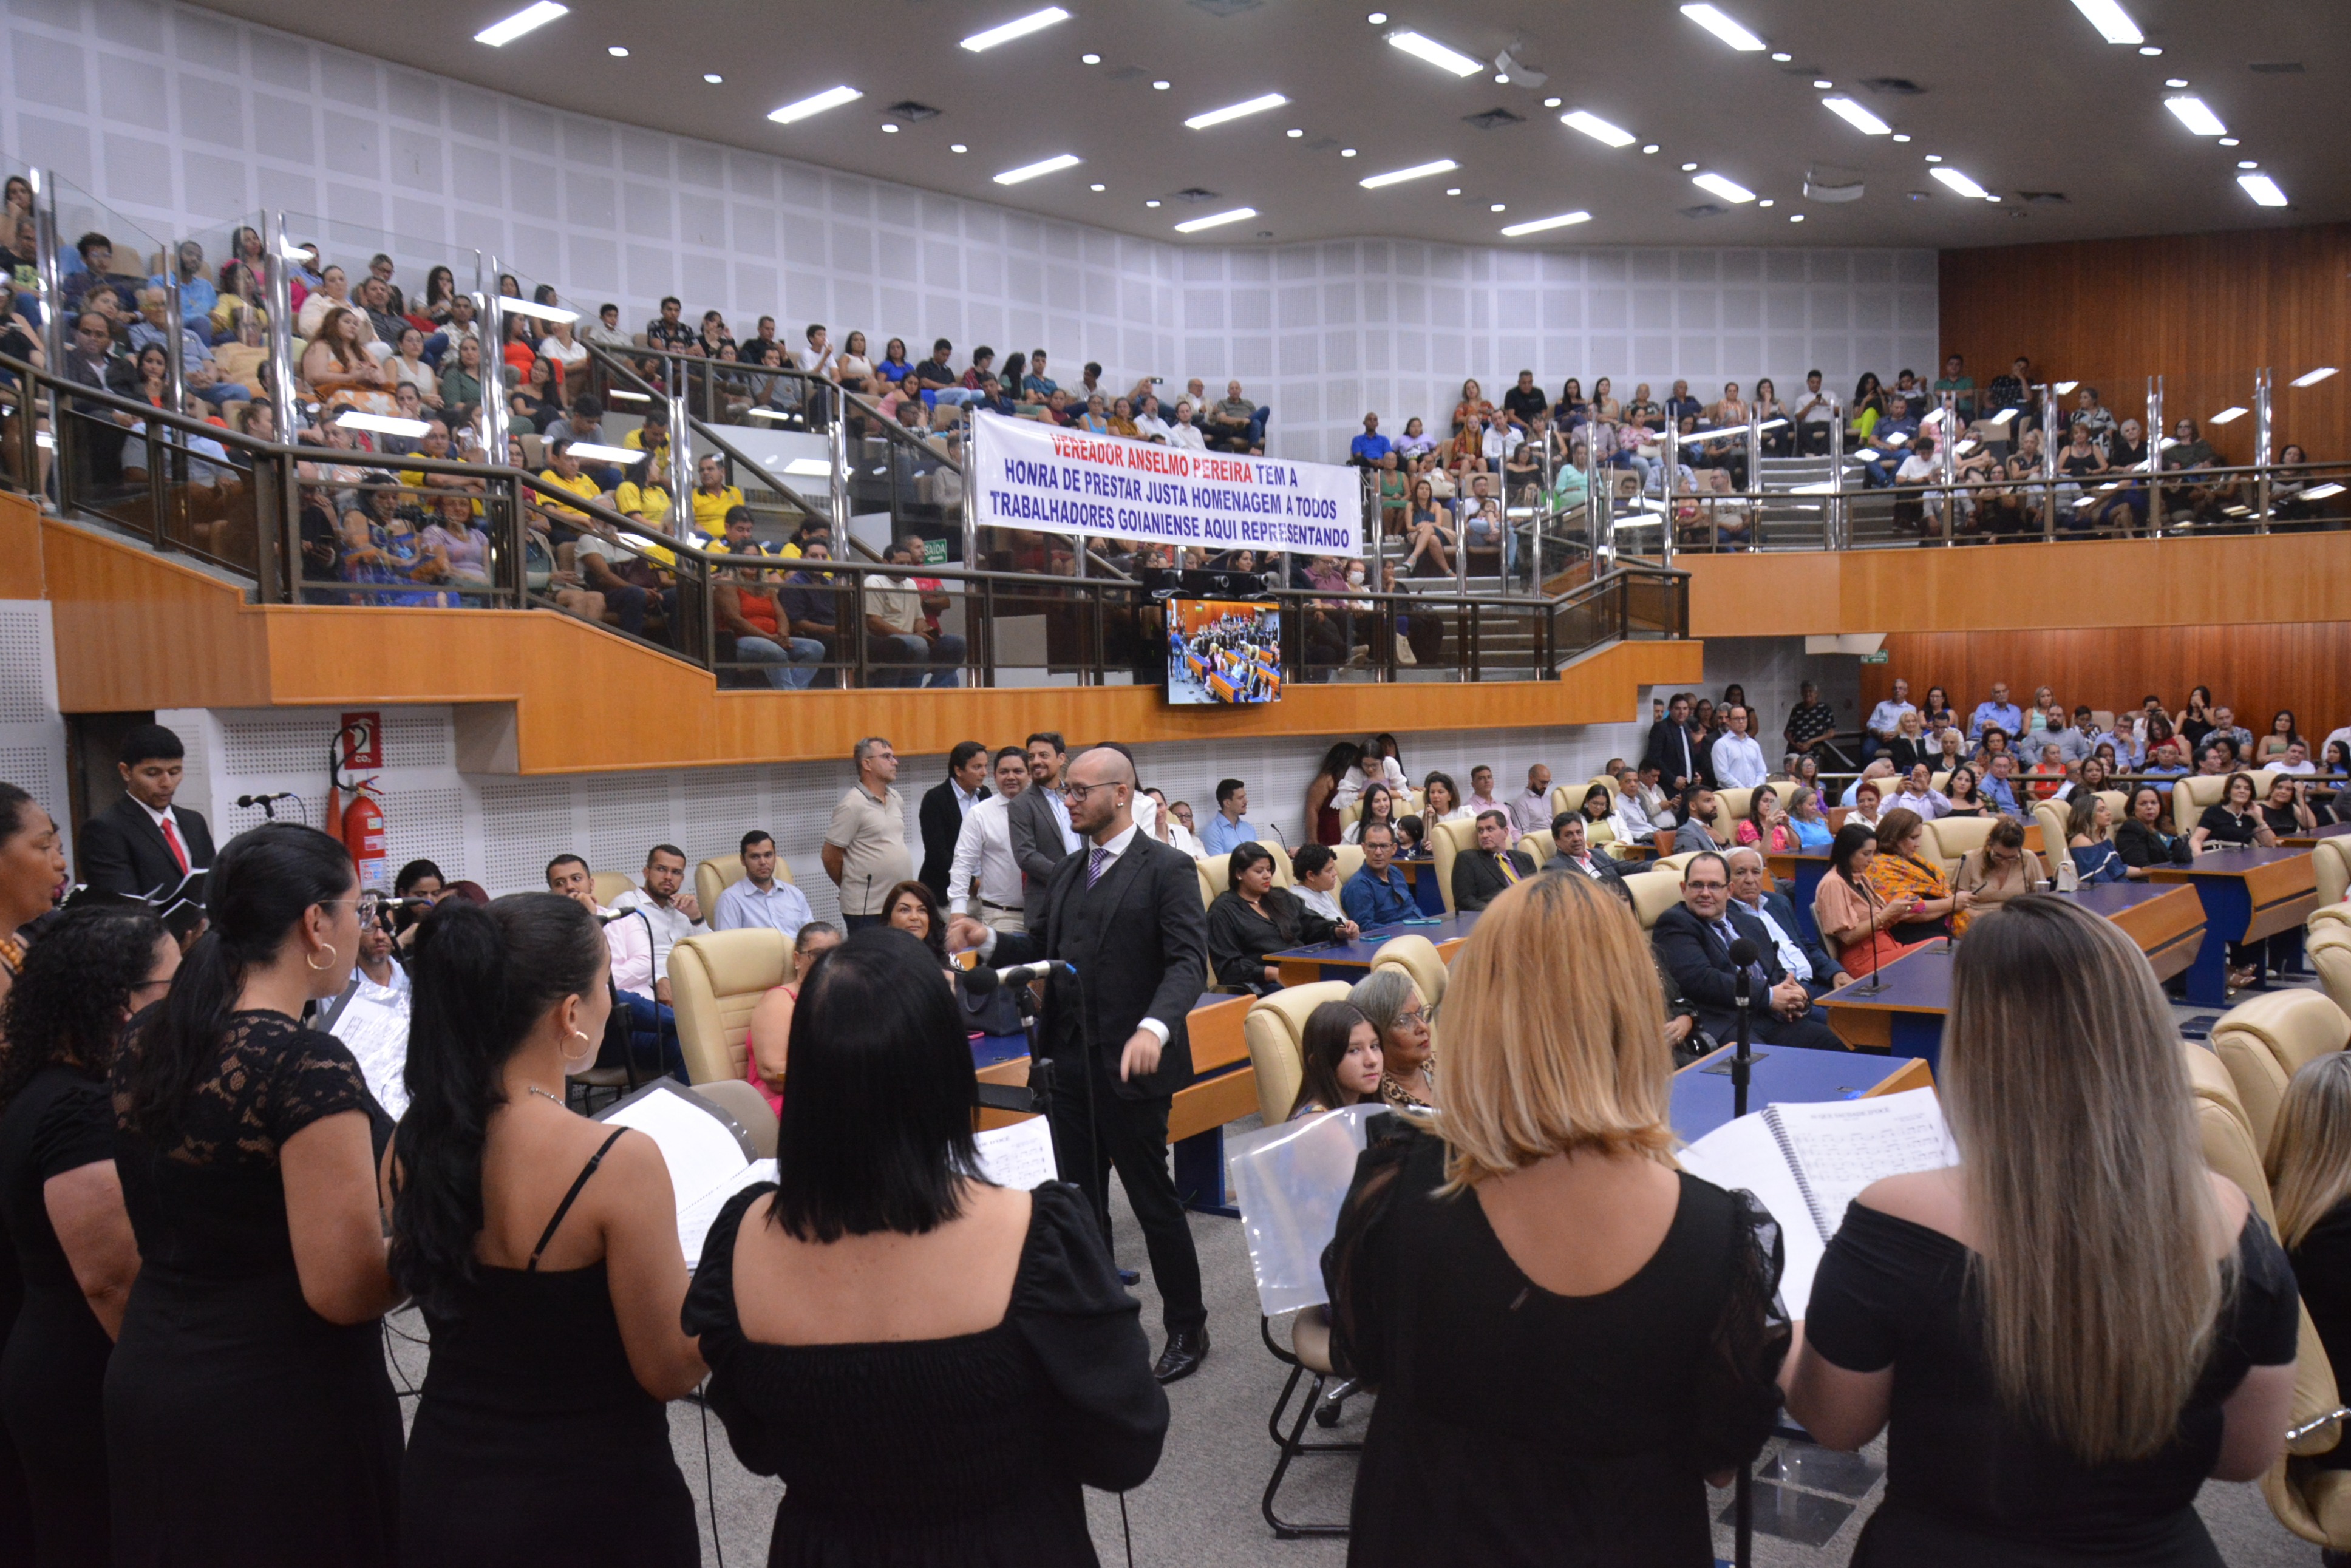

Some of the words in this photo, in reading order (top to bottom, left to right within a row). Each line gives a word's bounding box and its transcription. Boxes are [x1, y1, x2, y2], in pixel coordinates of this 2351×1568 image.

[1050, 433, 1124, 467] VEREADOR
[1128, 447, 1189, 477] ANSELMO
[1193, 456, 1253, 483] PEREIRA
[1256, 463, 1286, 486] TEM
[1290, 467, 1298, 487] A
[1004, 458, 1059, 489] HONRA
[1063, 467, 1081, 492] DE
[1084, 471, 1143, 501] PRESTAR
[1146, 481, 1188, 507] JUSTA
[1191, 486, 1282, 515] HOMENAGEM
[1286, 495, 1293, 515] A
[1295, 497, 1337, 520] TODOS
[990, 490, 1115, 529] TRABALHADORES
[1118, 508, 1200, 537] GOIANIENSE
[1204, 517, 1237, 540] AQUI
[1240, 520, 1349, 548] REPRESENTANDO
[924, 542, 945, 555] SAÍDA
